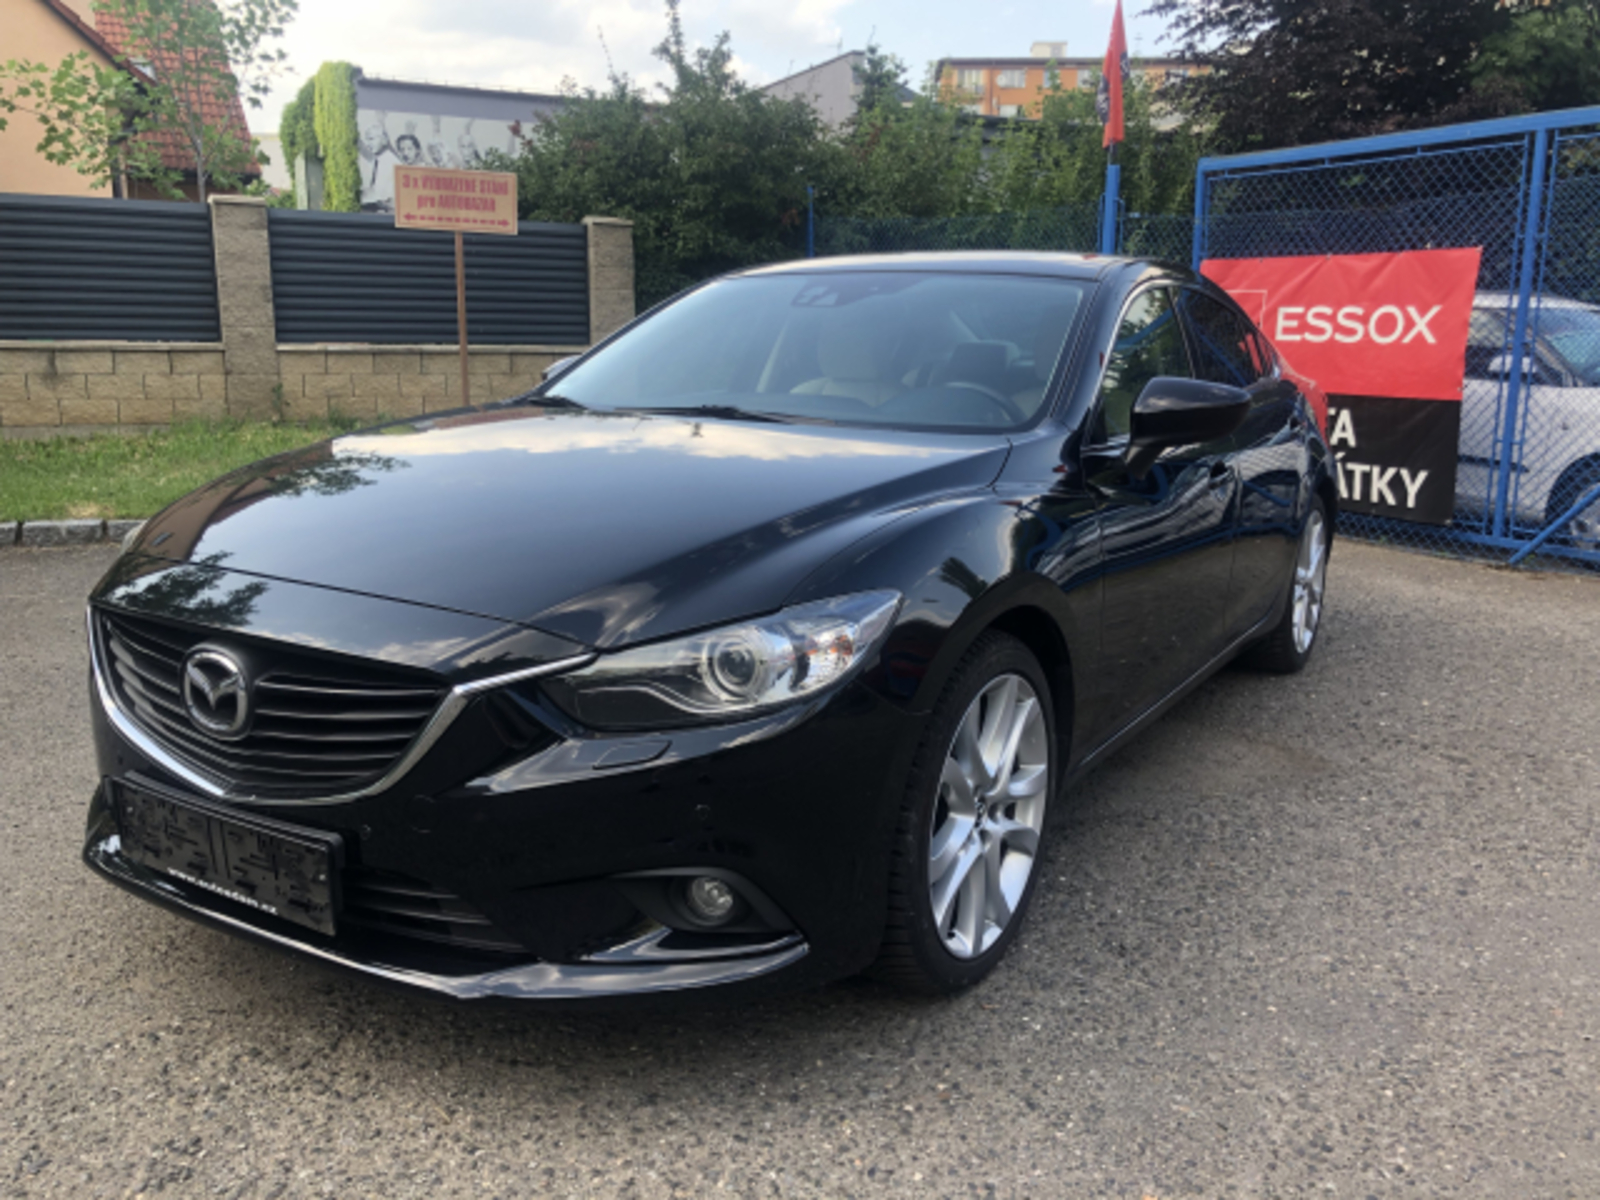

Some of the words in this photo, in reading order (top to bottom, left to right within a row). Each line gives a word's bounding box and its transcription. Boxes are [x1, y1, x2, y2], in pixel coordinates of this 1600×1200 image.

[402, 174, 411, 188] 3
[417, 194, 436, 210] pro
[1275, 305, 1442, 344] ESSOX
[1328, 407, 1356, 448] A
